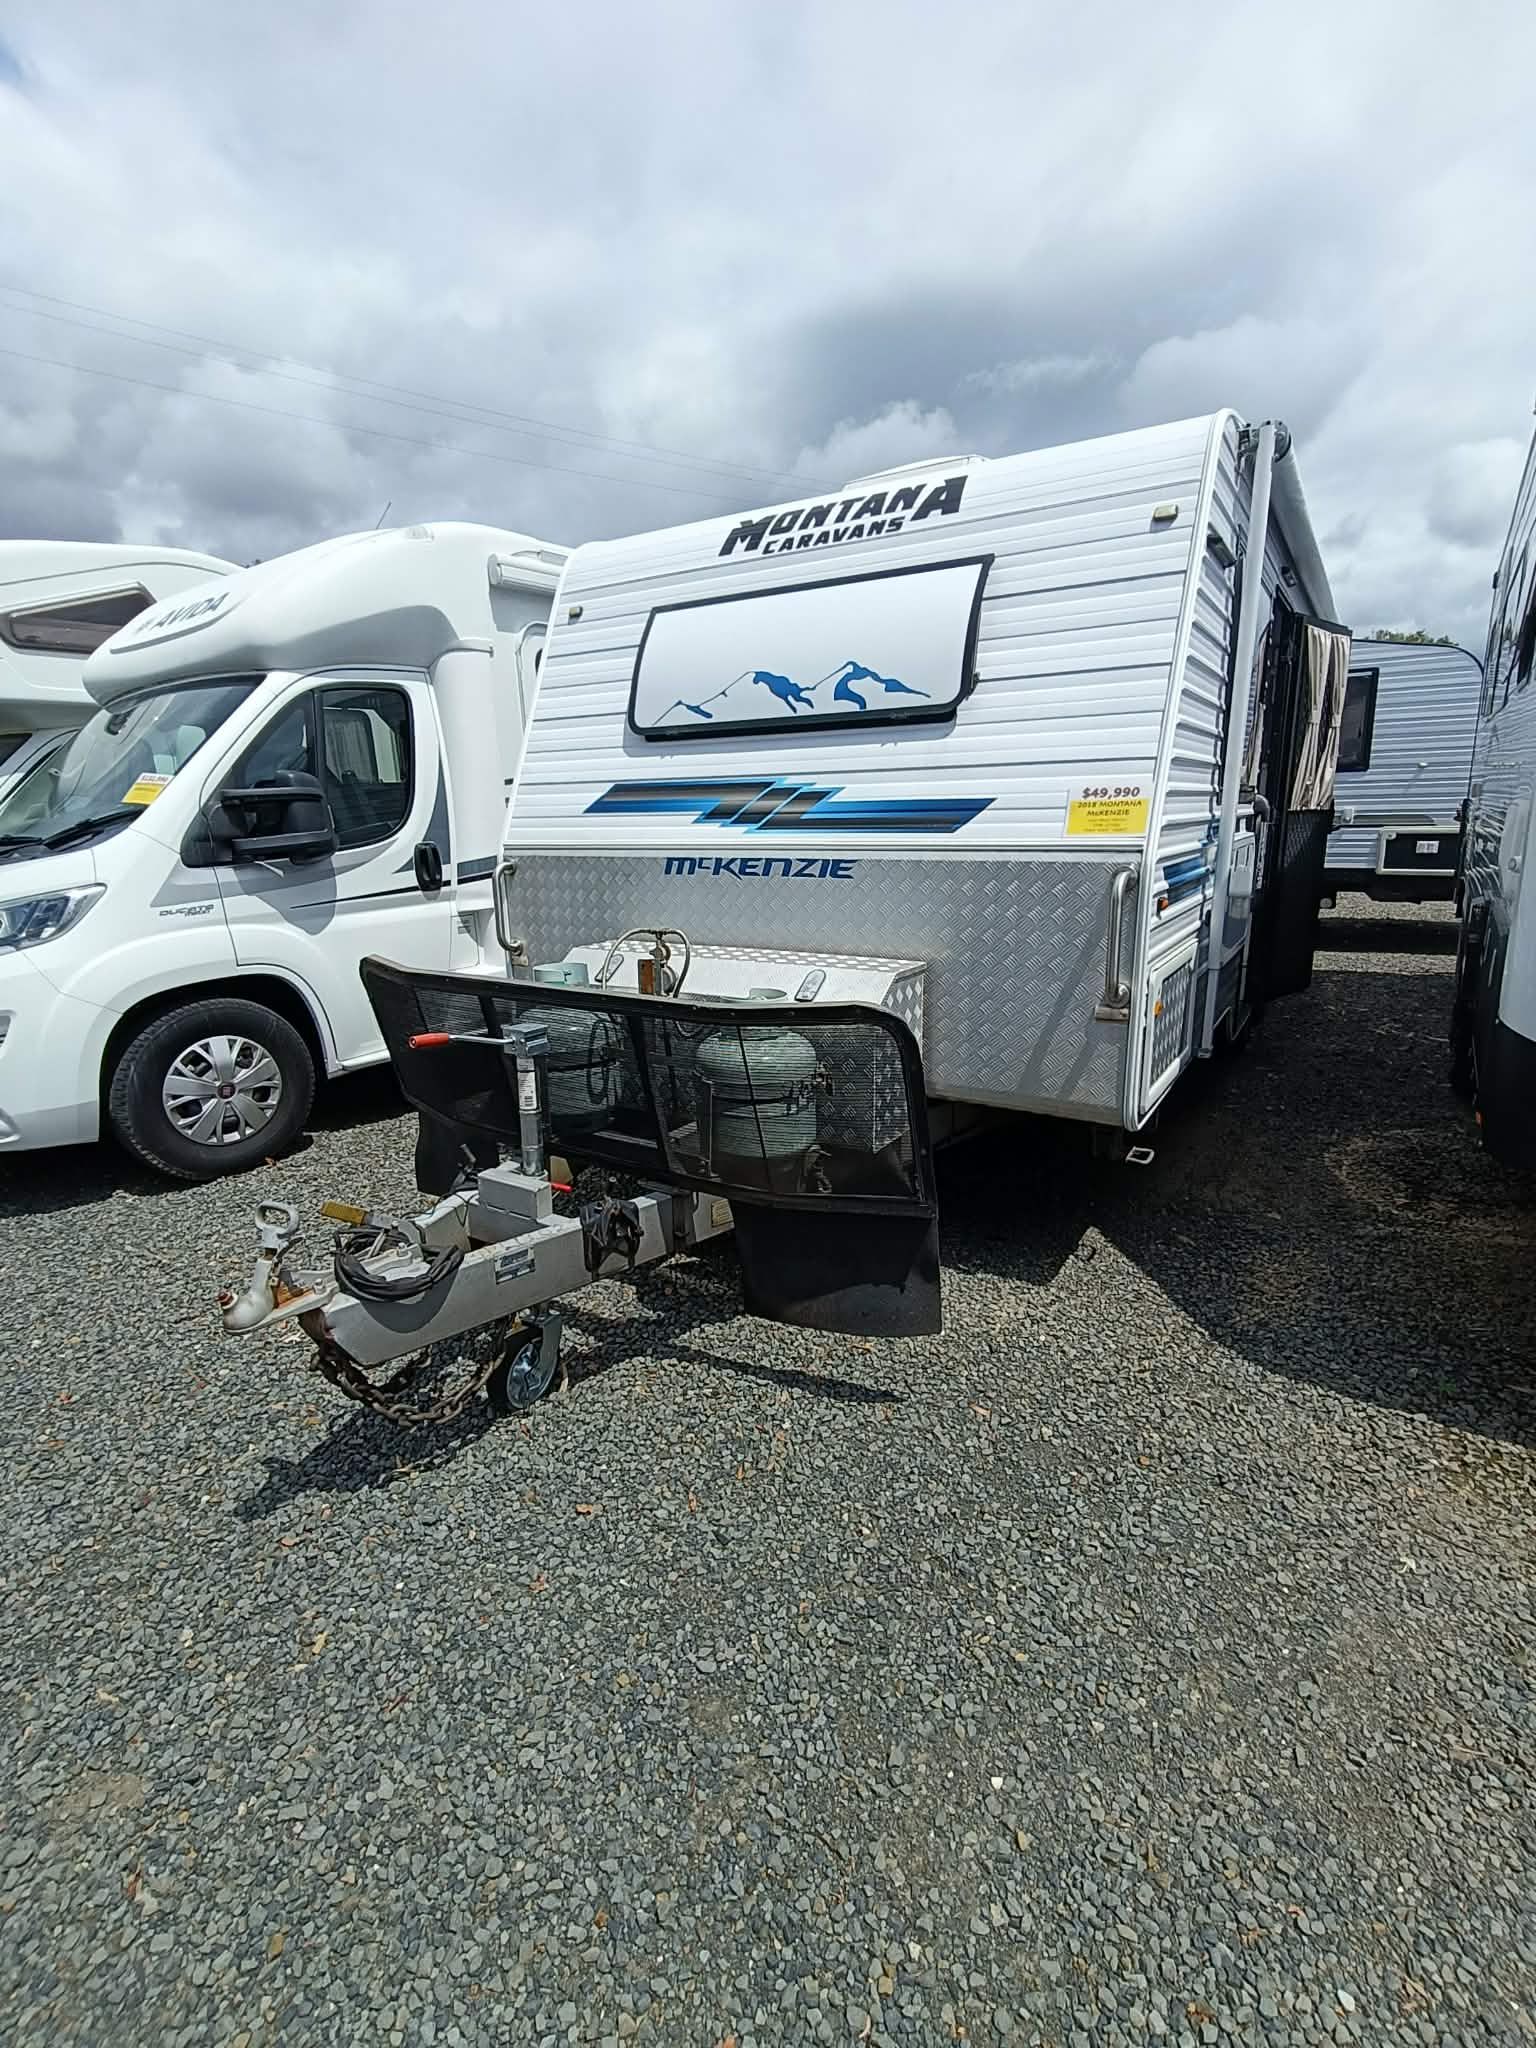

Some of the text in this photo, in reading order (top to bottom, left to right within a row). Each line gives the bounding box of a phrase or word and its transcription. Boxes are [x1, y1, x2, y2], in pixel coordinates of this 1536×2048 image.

[718, 475, 968, 556] MONTANA
[762, 516, 904, 555] CARAVANS
[149, 592, 230, 630] AVIDA
[1082, 787, 1140, 799] $49,990
[1100, 800, 1142, 808] MONTANA
